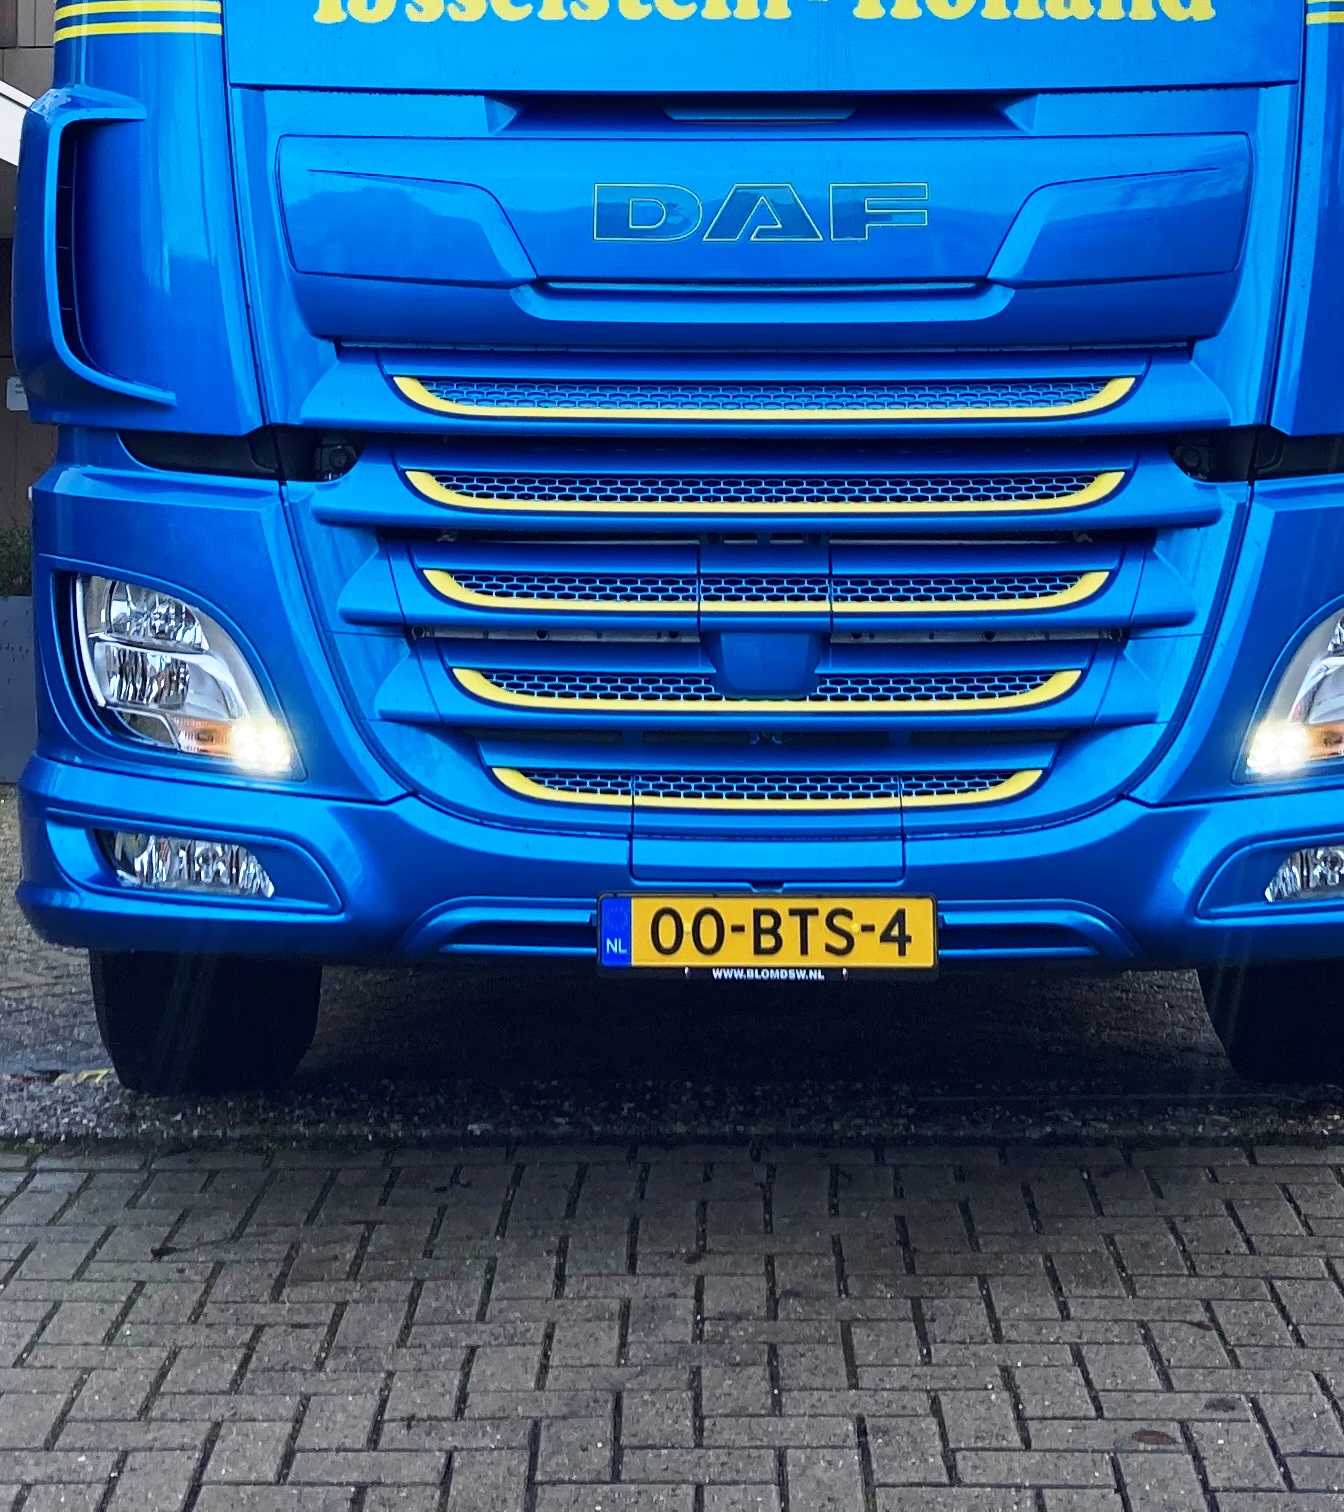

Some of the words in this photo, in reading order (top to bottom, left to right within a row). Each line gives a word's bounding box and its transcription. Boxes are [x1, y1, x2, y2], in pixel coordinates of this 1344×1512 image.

[594, 182, 929, 241] DAF
[606, 938, 627, 954] NL
[650, 906, 912, 957] 00-BTS-4
